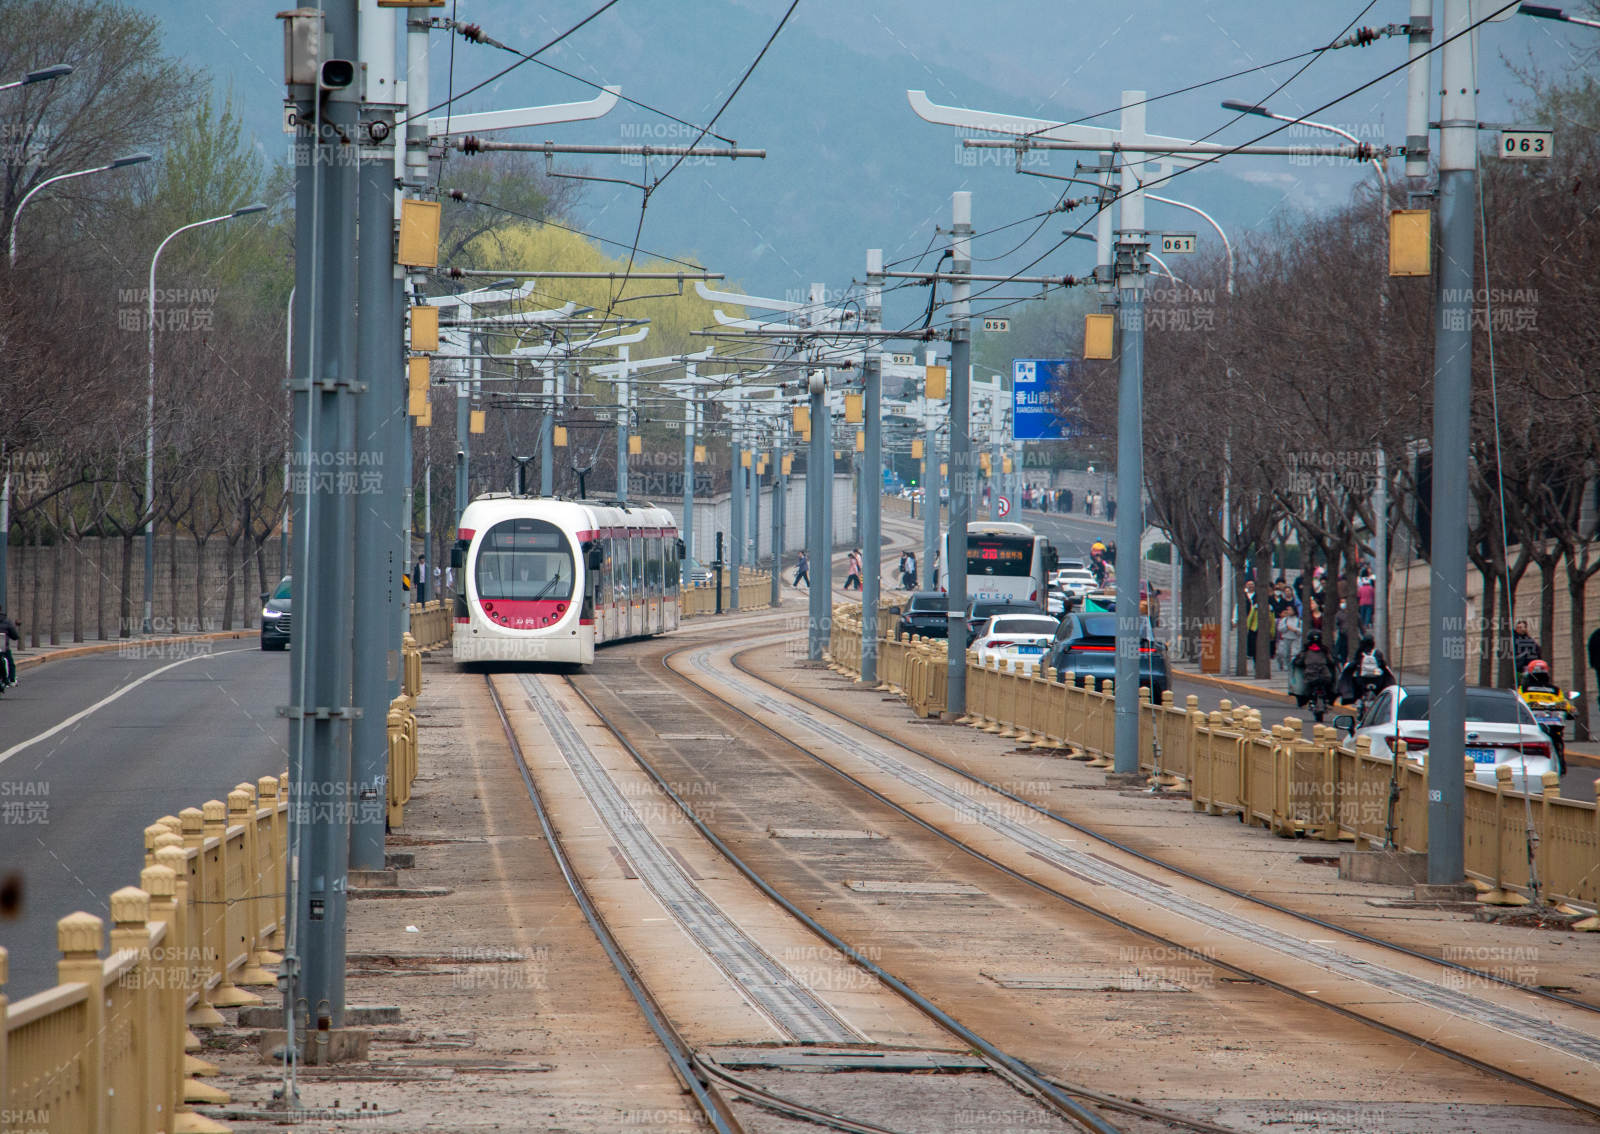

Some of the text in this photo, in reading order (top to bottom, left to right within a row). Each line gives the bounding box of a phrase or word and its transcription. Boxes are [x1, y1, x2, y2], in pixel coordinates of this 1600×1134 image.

[1505, 138, 1544, 152] 063
[1164, 240, 1190, 249] 061
[985, 321, 1006, 330] 059
